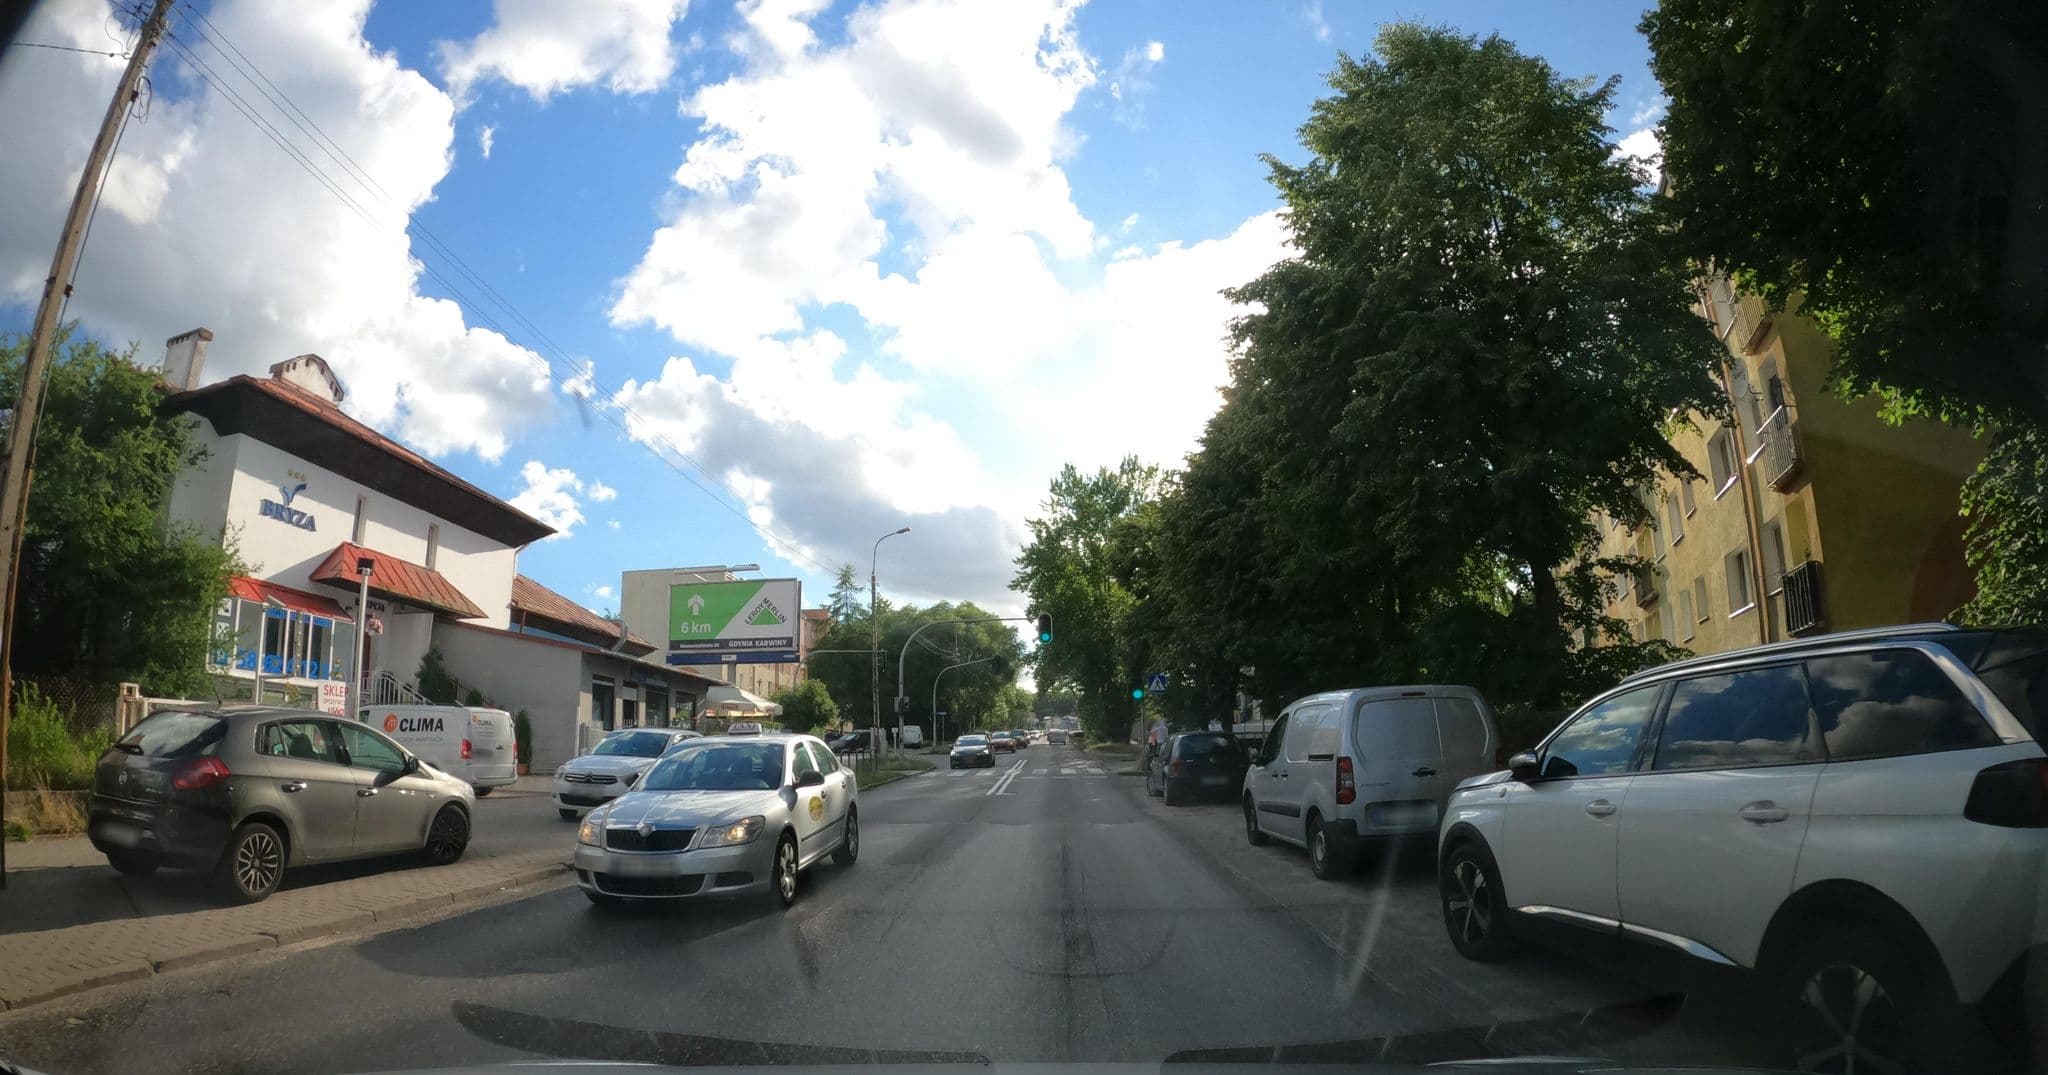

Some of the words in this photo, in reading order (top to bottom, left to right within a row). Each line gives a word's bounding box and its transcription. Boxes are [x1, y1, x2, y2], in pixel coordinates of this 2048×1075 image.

[259, 499, 316, 531] BRYZA
[744, 601, 765, 625] LEROY
[762, 597, 788, 623] MERLIN
[681, 622, 689, 634] 6
[692, 622, 711, 633] km
[728, 640, 754, 648] GDYNIA
[755, 639, 788, 647] KARWINY
[323, 684, 350, 698] SKLEP
[399, 718, 444, 732] CLIMA
